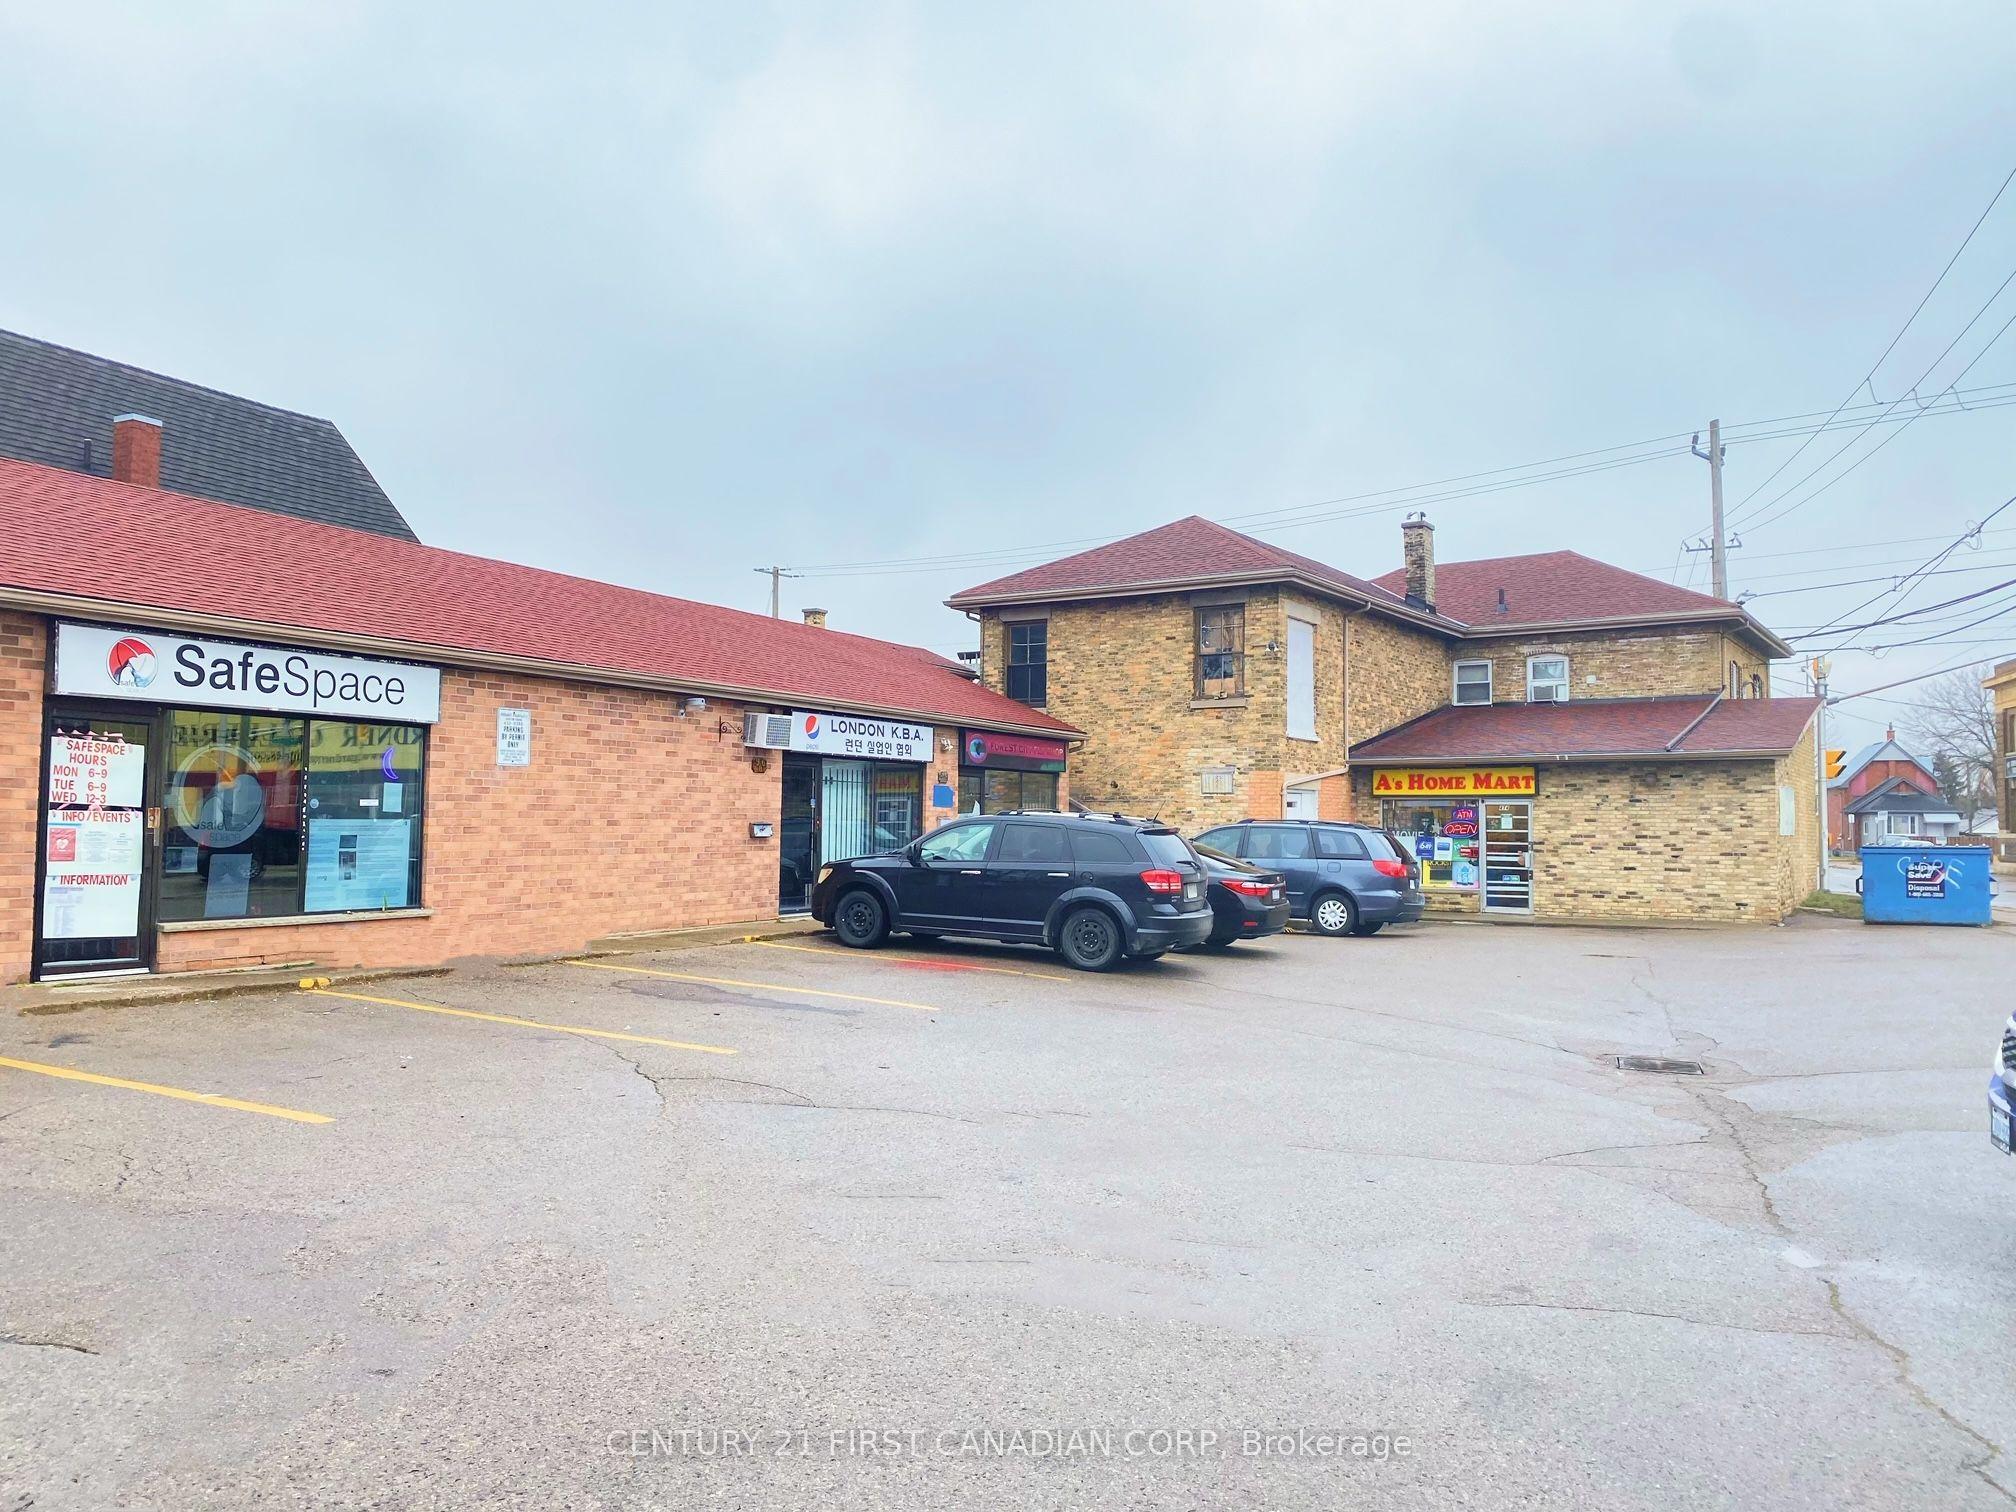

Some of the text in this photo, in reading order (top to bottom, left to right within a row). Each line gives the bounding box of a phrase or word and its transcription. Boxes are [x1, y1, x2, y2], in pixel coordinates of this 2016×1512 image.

[174, 644, 405, 708] SafeSpace
[831, 720, 924, 742] LONDON K.B.A.
[845, 738, 863, 753] 런던
[866, 740, 892, 756] 실업인
[69, 753, 107, 766] HOURS
[53, 765, 108, 778] MON 6-9
[54, 779, 107, 792] TUE 6-9
[51, 791, 106, 804] WED 12-3
[1457, 809, 1473, 819] ATM
[1444, 824, 1478, 835] OPEN
[60, 874, 129, 886] INFORMATION
[1908, 884, 1940, 893] Disposal
